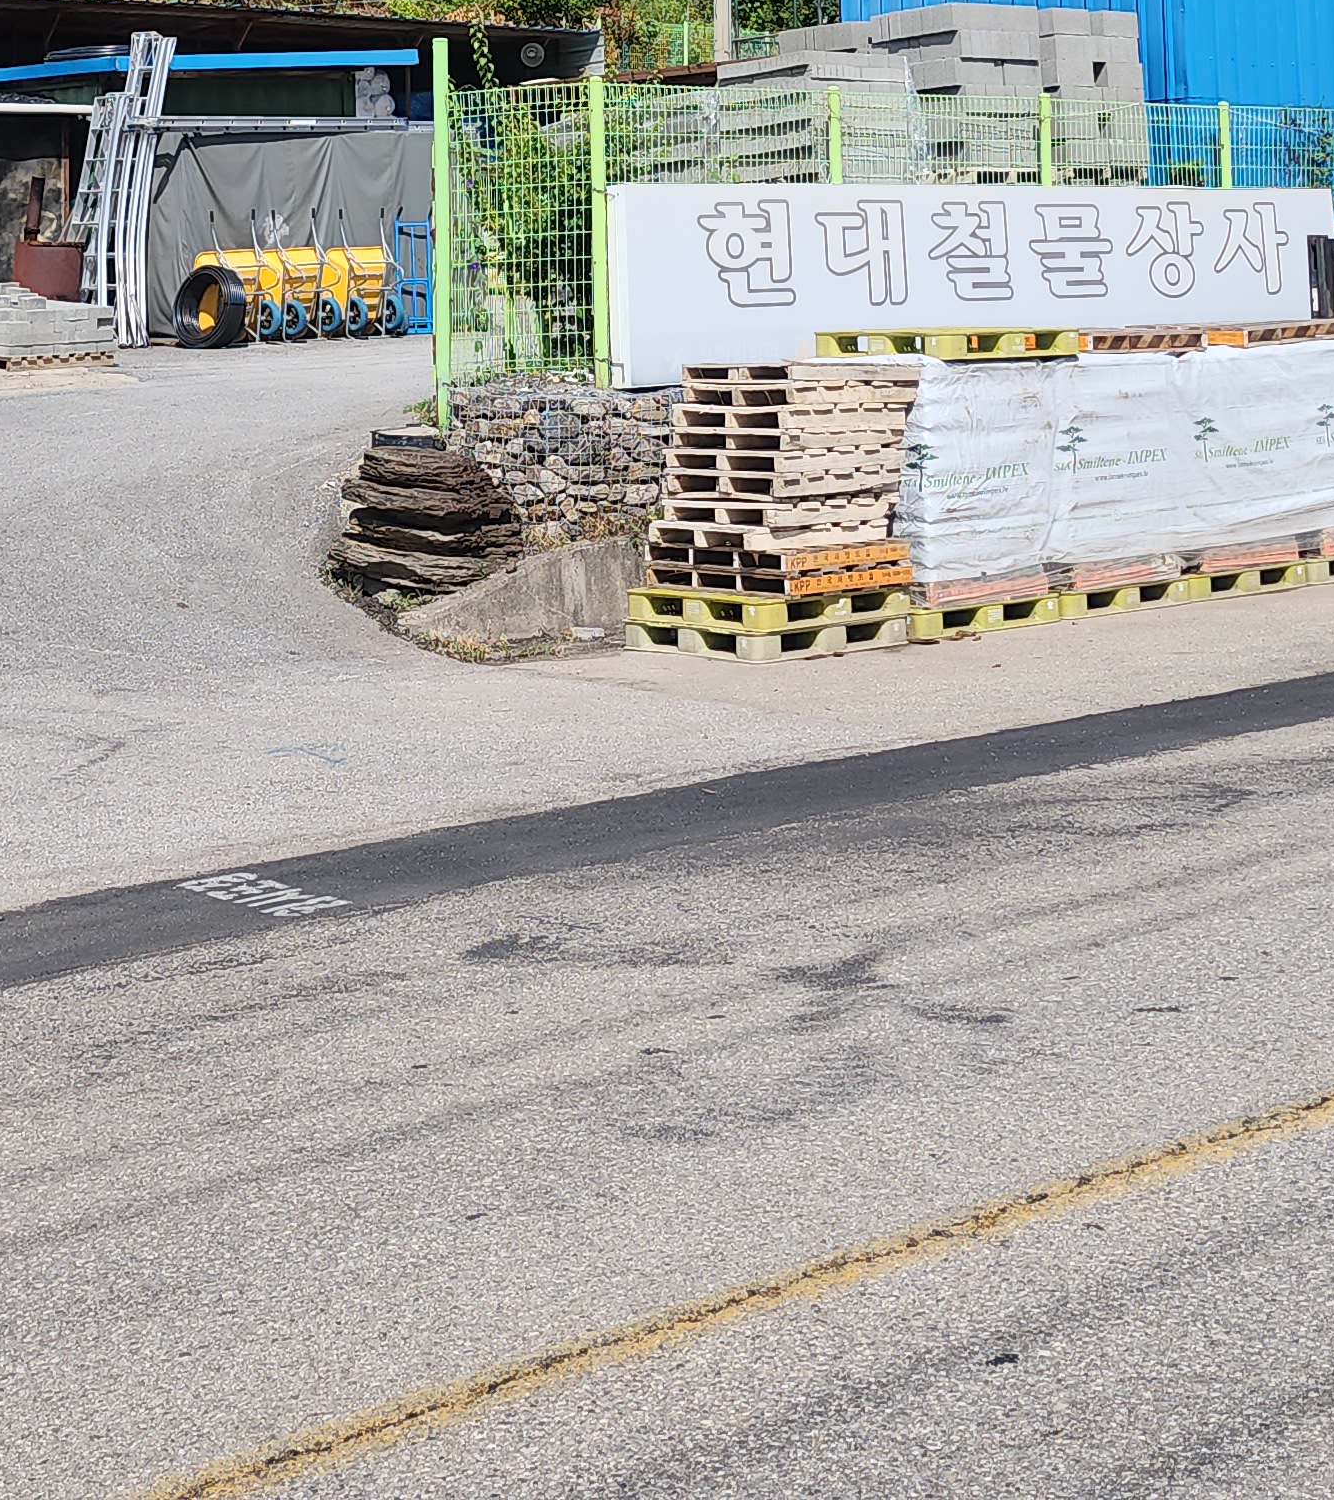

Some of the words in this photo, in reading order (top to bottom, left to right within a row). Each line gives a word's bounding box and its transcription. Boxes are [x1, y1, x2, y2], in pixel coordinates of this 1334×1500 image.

[696, 198, 1290, 308] 현대철물상사
[1254, 436, 1292, 454] IMPEX
[1077, 455, 1122, 471] Smiltene
[1127, 447, 1167, 465] IMPEX
[986, 461, 1031, 481] IMPEX
[794, 580, 811, 593] KPP
